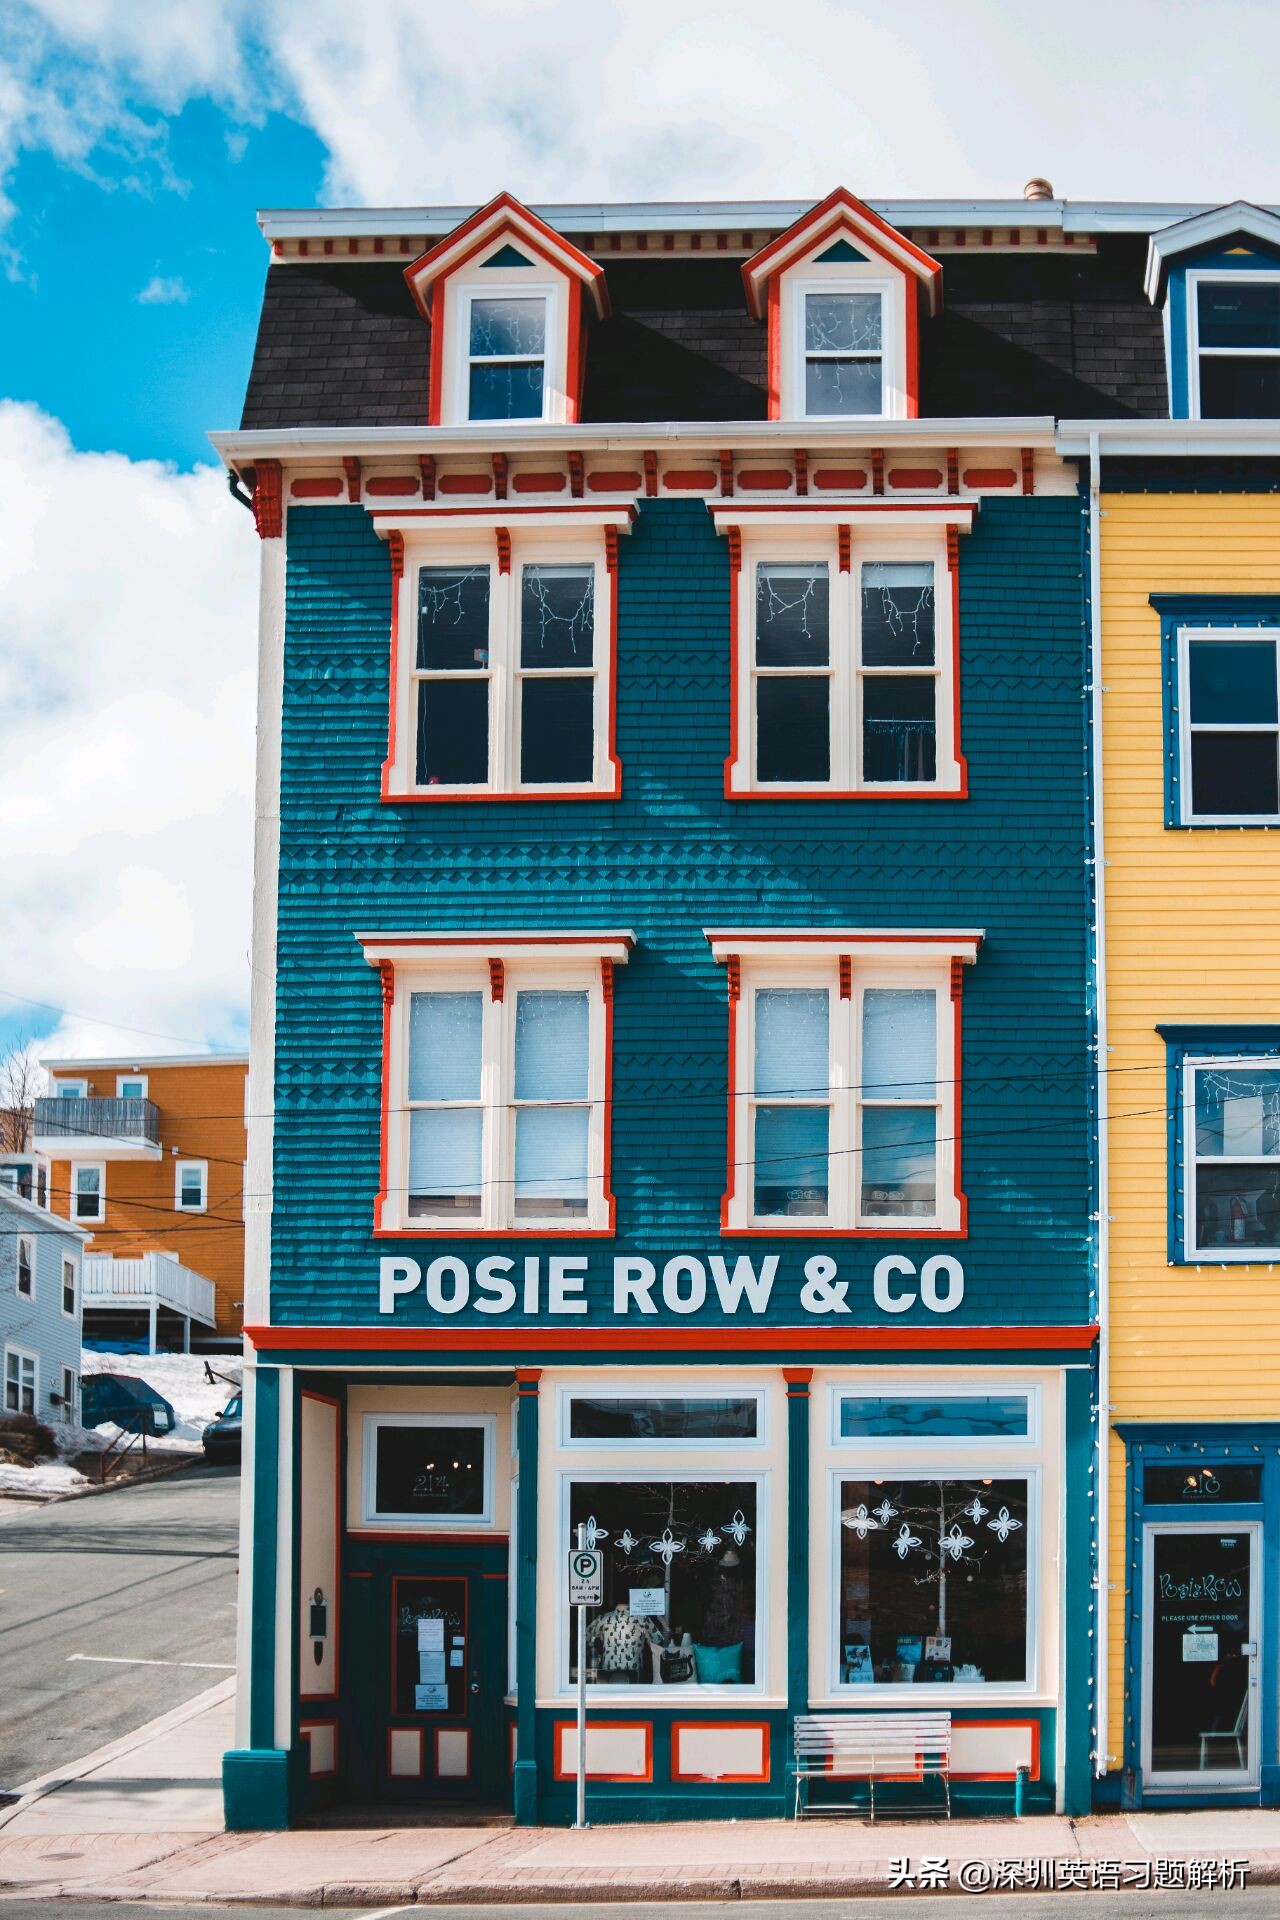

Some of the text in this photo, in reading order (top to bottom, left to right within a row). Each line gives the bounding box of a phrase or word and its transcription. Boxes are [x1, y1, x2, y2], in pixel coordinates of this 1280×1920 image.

[379, 1254, 965, 1314] POSIE ROW & CO
[412, 1474, 450, 1493] 214
[580, 1558, 592, 1573] P
